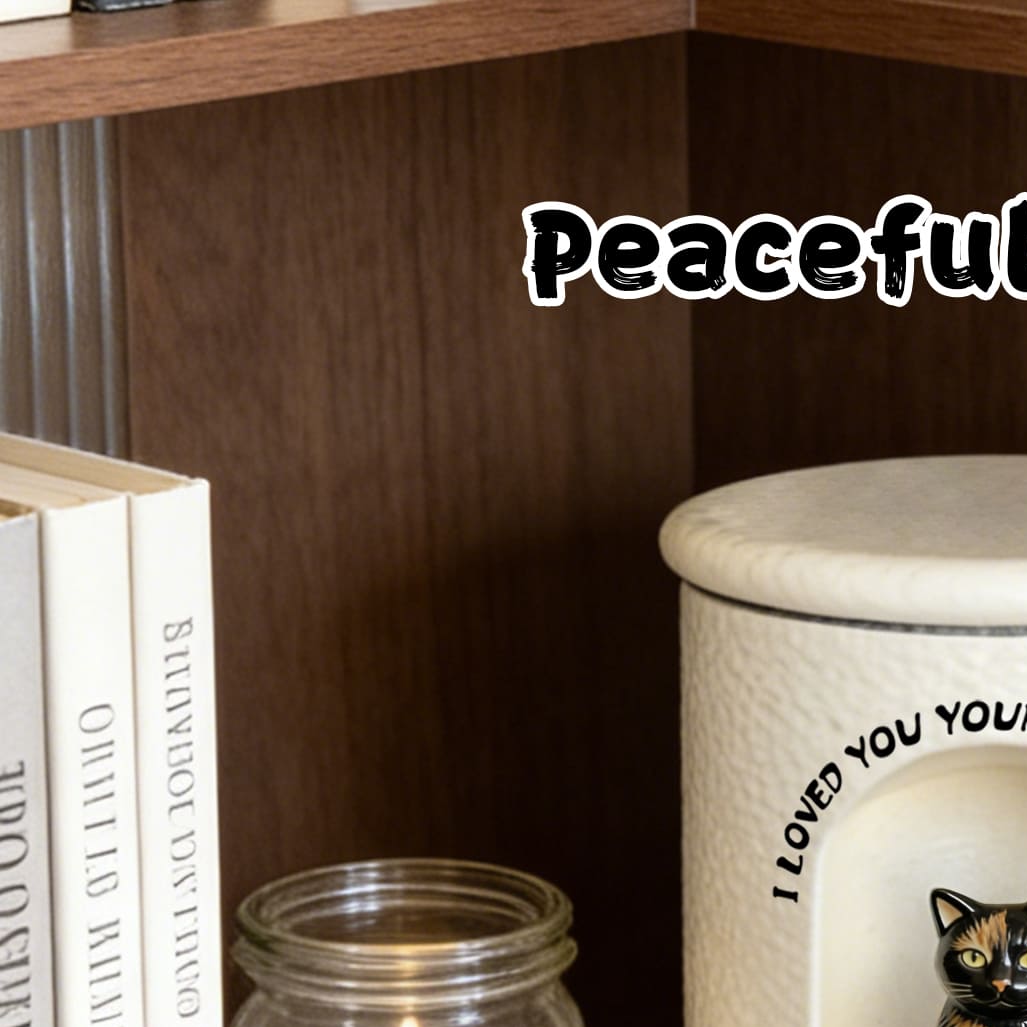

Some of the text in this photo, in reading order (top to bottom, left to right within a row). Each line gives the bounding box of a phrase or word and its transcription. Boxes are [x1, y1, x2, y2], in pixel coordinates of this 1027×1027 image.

[844, 712, 922, 769] YOU
[775, 761, 843, 876] LOVED
[772, 885, 799, 904] I
